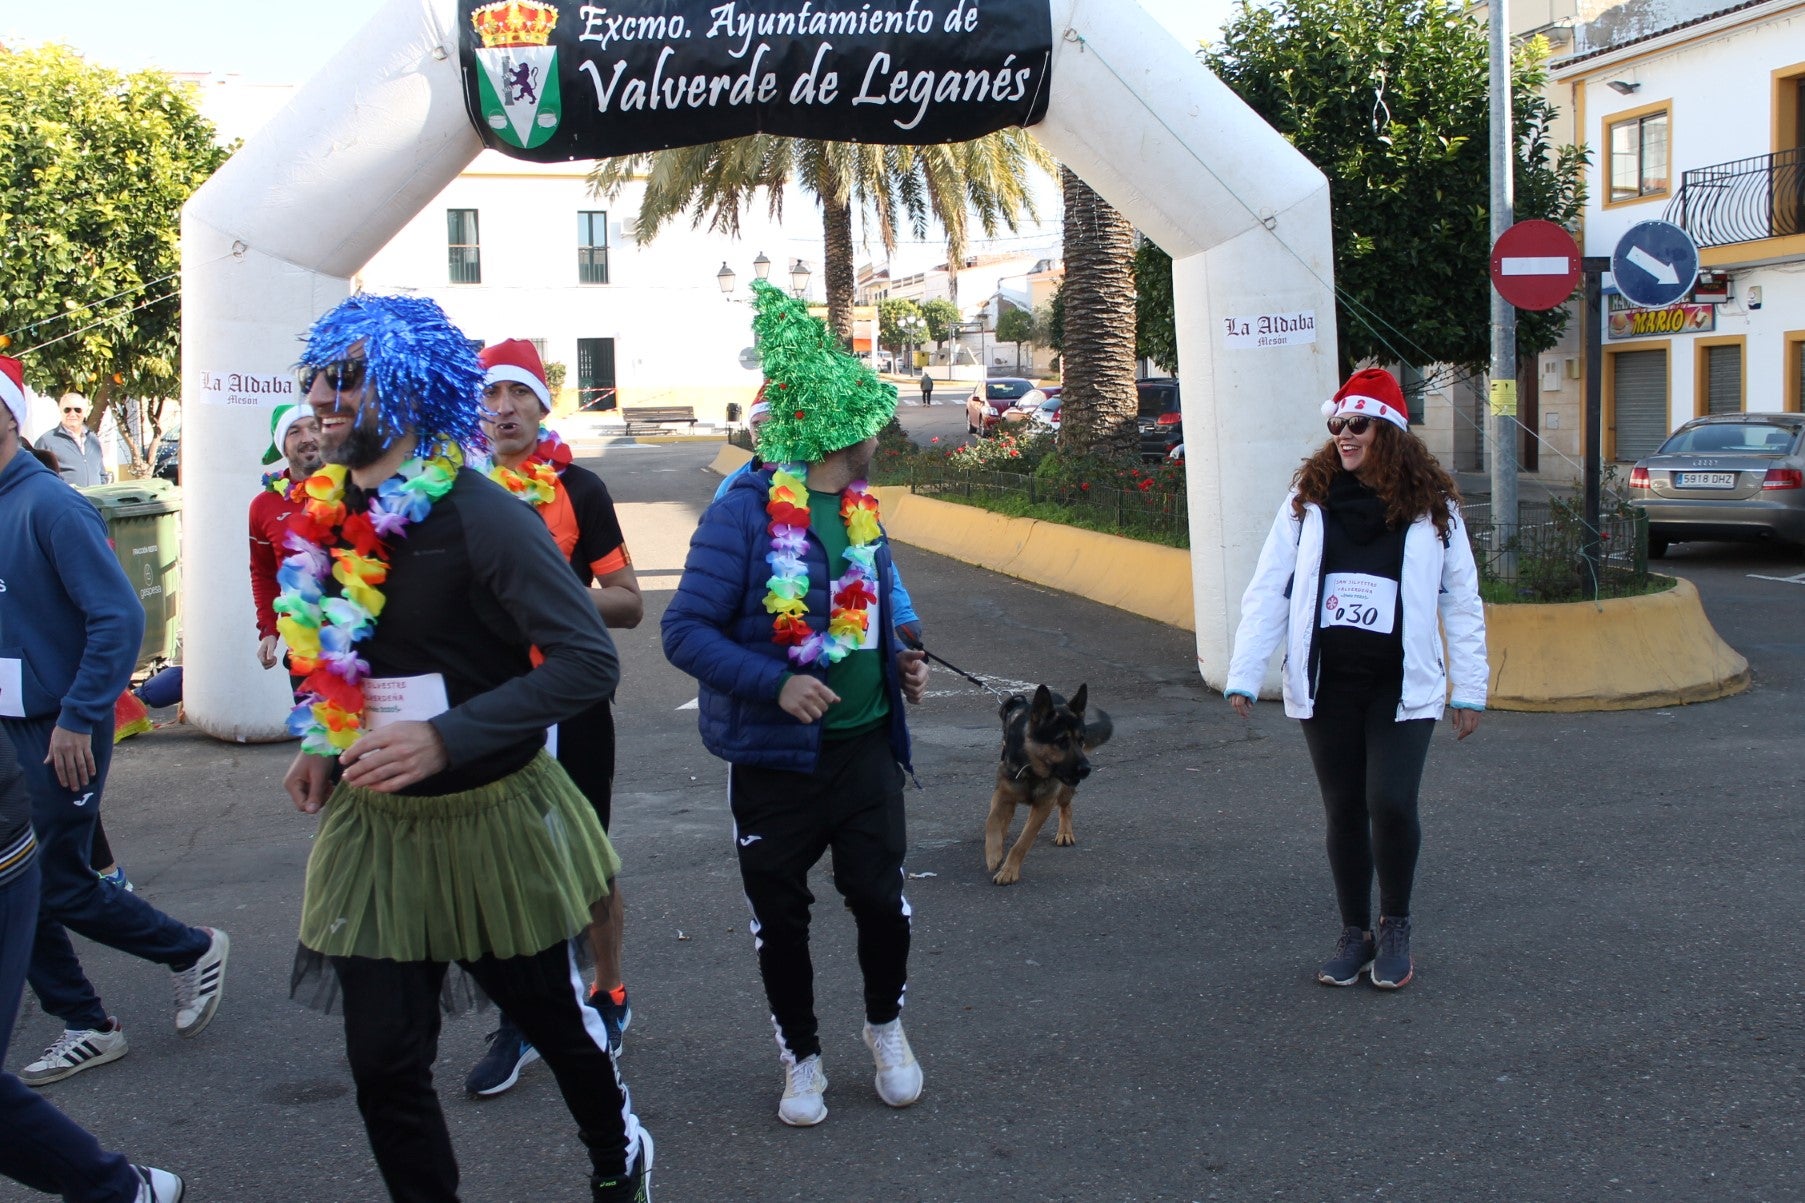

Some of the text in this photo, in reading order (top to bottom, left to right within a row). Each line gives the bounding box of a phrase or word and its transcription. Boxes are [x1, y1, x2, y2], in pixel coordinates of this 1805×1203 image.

[579, 0, 978, 58] Excmo. Ayuntamiento de
[579, 41, 1031, 130] Valverde de Leganés
[1224, 313, 1315, 337] La Aldaba
[1632, 308, 1686, 335] MARIO
[201, 370, 292, 394] La Aldaba
[1684, 474, 1732, 484] 5918 DHZ
[1335, 604, 1378, 626] 030
